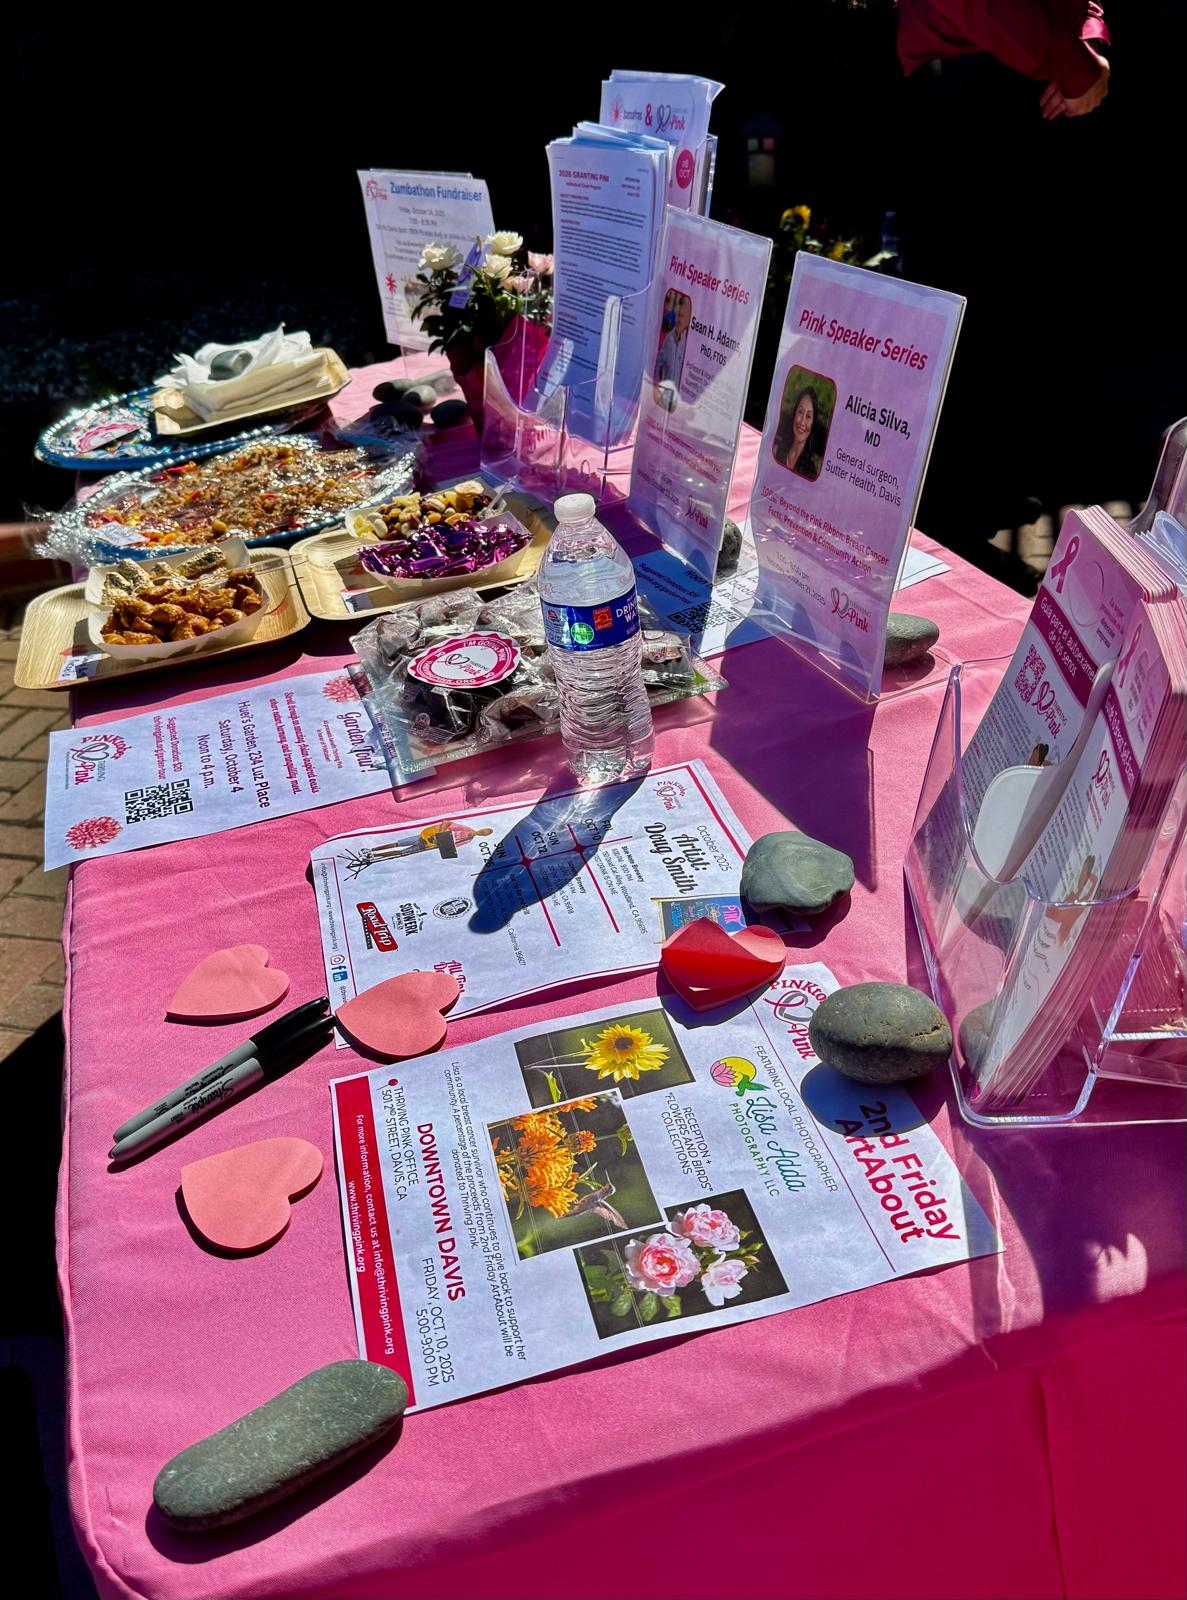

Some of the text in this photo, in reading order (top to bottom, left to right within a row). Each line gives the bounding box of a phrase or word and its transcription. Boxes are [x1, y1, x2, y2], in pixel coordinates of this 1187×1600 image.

[644, 104, 652, 126] &
[390, 182, 482, 201] Zumbathon Fundraiser
[669, 255, 750, 305] Pink Speaker Series
[690, 316, 707, 334] Sean
[799, 309, 928, 371] Pink Speaker Series
[845, 395, 911, 440] Alicia Silva,
[864, 429, 881, 448] MD
[825, 460, 902, 507] Sutter Health, Davis
[836, 448, 899, 489] General surgeon,
[768, 505, 872, 574] Facts, Prevention & Community Action
[780, 496, 801, 515] Beyond
[800, 505, 810, 520] the
[810, 513, 824, 529] Pink
[845, 533, 866, 552] Breast
[865, 545, 889, 566] Cancer
[616, 601, 637, 618] DRIN
[848, 607, 869, 633] Pink
[1048, 629, 1077, 676] de los senos
[1049, 614, 1094, 680] para el autoexame
[459, 664, 481, 676] Pink
[218, 719, 235, 754] Saturday,
[242, 724, 257, 752] Garden,
[1046, 708, 1062, 740] Pink
[80, 734, 133, 760] PINKtober
[166, 716, 182, 772] Suggested $20
[197, 734, 210, 754] Noon
[200, 754, 212, 763] to
[248, 750, 263, 765] 234
[293, 726, 320, 793] amazing oasis
[336, 712, 382, 772] Garden Tour!
[74, 758, 96, 785] Pink
[198, 771, 215, 789] p.m.
[225, 754, 240, 784] October
[252, 765, 264, 781] Luz
[255, 781, 270, 808] Place
[530, 830, 548, 854] OCT 12
[546, 831, 560, 846] SUN
[583, 818, 601, 841] OCT 10
[599, 819, 613, 833] FRI
[476, 840, 495, 867] OCT 26
[492, 842, 507, 859] SUN
[644, 822, 674, 854] Doug
[662, 856, 698, 894] Smith
[671, 834, 710, 871] Artist:
[696, 825, 732, 871] October 2025
[631, 864, 645, 882] Brewery
[361, 905, 388, 928] Road
[631, 909, 640, 918] CA
[374, 928, 392, 946] Trip
[505, 927, 522, 951] California
[446, 960, 464, 975] All
[787, 1024, 816, 1060] Pink
[356, 1114, 364, 1125] For
[394, 1086, 419, 1186] THRIVING PINK OFFICE
[682, 1106, 711, 1158] RECEPTION
[754, 1045, 838, 1192] FEATURING LOCAL PHOTOGRAPHER
[381, 1089, 408, 1201] 501 STREET, DAVIS, CA
[661, 1111, 693, 1175] COLLECTIONS
[680, 1130, 698, 1158] AND
[728, 1102, 780, 1197] PHOTOGRAPHY LLC
[745, 1096, 807, 1192] Lisa Adda
[360, 1144, 372, 1192] information,
[835, 1118, 927, 1244] ArtAbout
[859, 1101, 960, 1241] 2nd Friday
[366, 1194, 376, 1226] contact
[417, 1123, 466, 1301] DOWNTOWN DAVIS
[444, 1069, 512, 1343] community. percentage of the proceeds from 2nd Friday ArtAbout will
[451, 1149, 480, 1250] donated Thriving Pink.
[451, 1062, 526, 1360] Lisa local breast cancer survivor who continues give back support her
[348, 1180, 366, 1274] www.thrivingpink.org
[370, 1227, 378, 1238] us
[374, 1250, 394, 1354] info@thrivingpink.org
[422, 1257, 455, 1383] FRIDAY, OCT. 10, 2025
[416, 1308, 440, 1387] 5:00-9:00 PM
